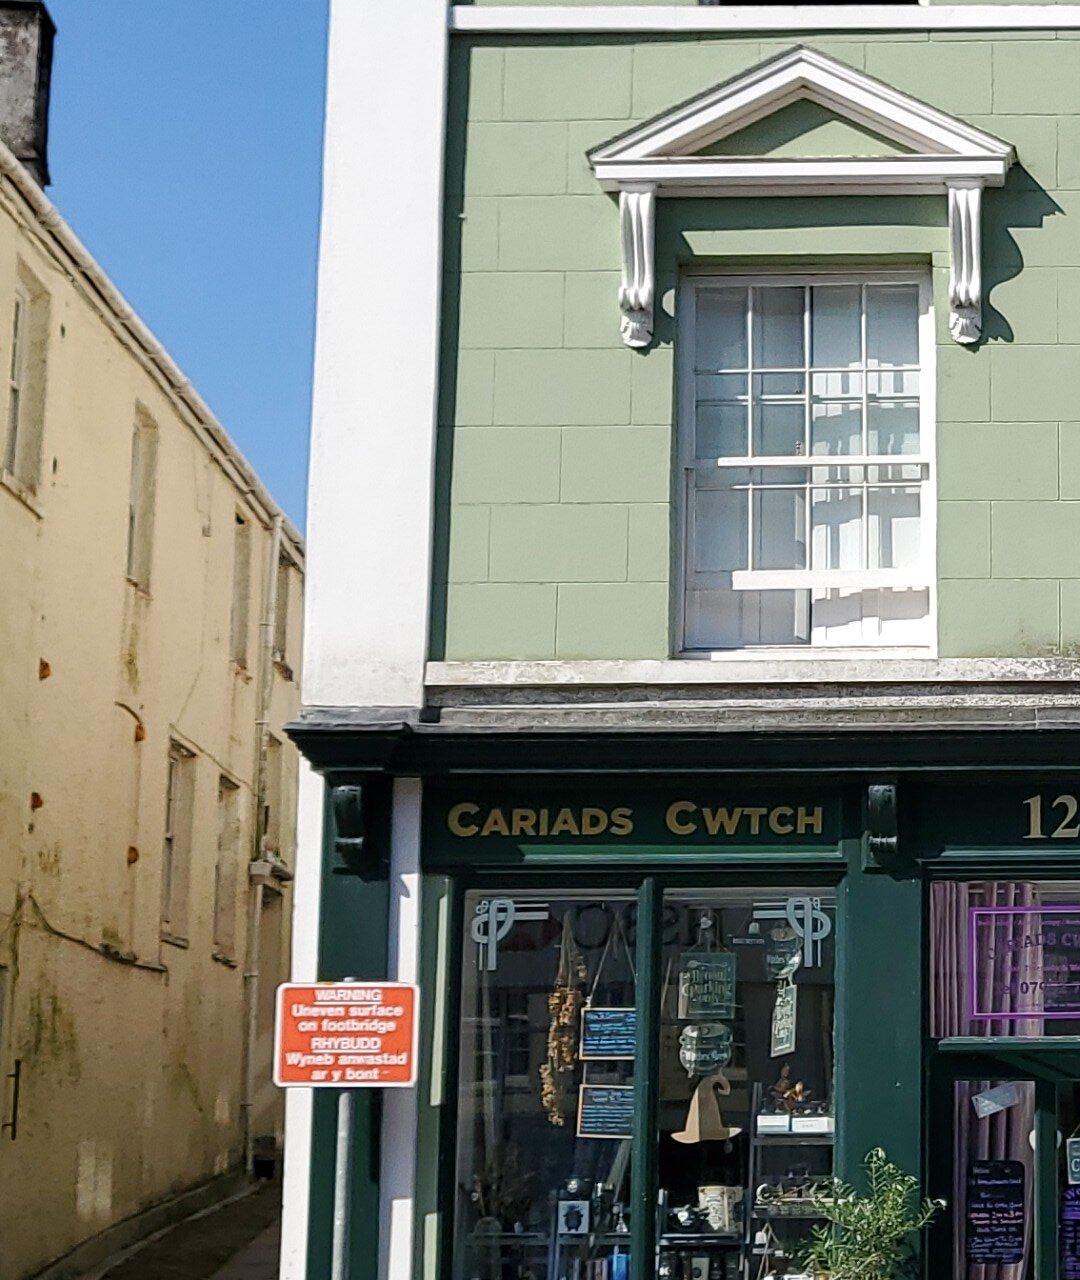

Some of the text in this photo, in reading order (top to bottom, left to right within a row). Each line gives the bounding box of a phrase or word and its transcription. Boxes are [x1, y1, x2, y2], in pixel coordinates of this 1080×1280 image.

[447, 801, 824, 837] CARIADS CWTCH
[1022, 794, 1080, 839] 12
[314, 988, 383, 1001] WARNING
[291, 1004, 404, 1017] Uneven surface
[297, 1018, 397, 1034] on footbridge
[311, 1037, 382, 1050] RHYBUDD
[285, 1052, 409, 1067] Wyneb anwastad
[311, 1068, 380, 1082] ar y bont
